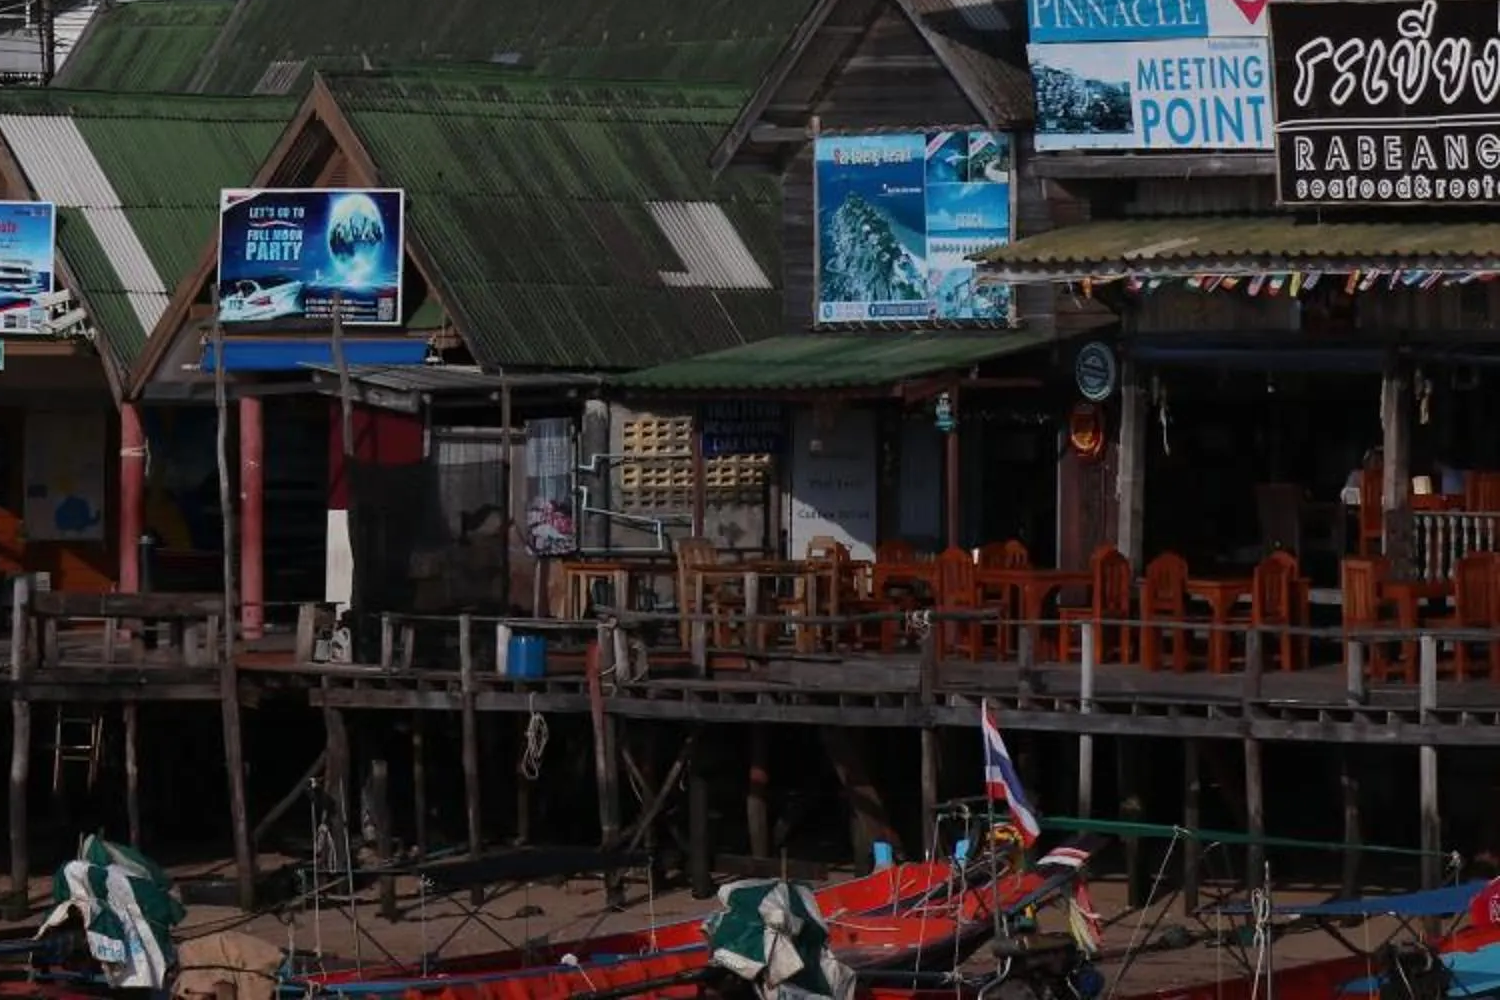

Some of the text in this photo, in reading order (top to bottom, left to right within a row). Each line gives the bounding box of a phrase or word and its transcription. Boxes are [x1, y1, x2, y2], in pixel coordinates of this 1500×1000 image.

[1136, 55, 1265, 91] MEETING
[1139, 95, 1266, 145] POINT
[1294, 133, 1500, 171] RABEANG
[1296, 174, 1500, 199] seafood&rest
[293, 207, 305, 218] TO
[246, 241, 303, 261] PARTY
